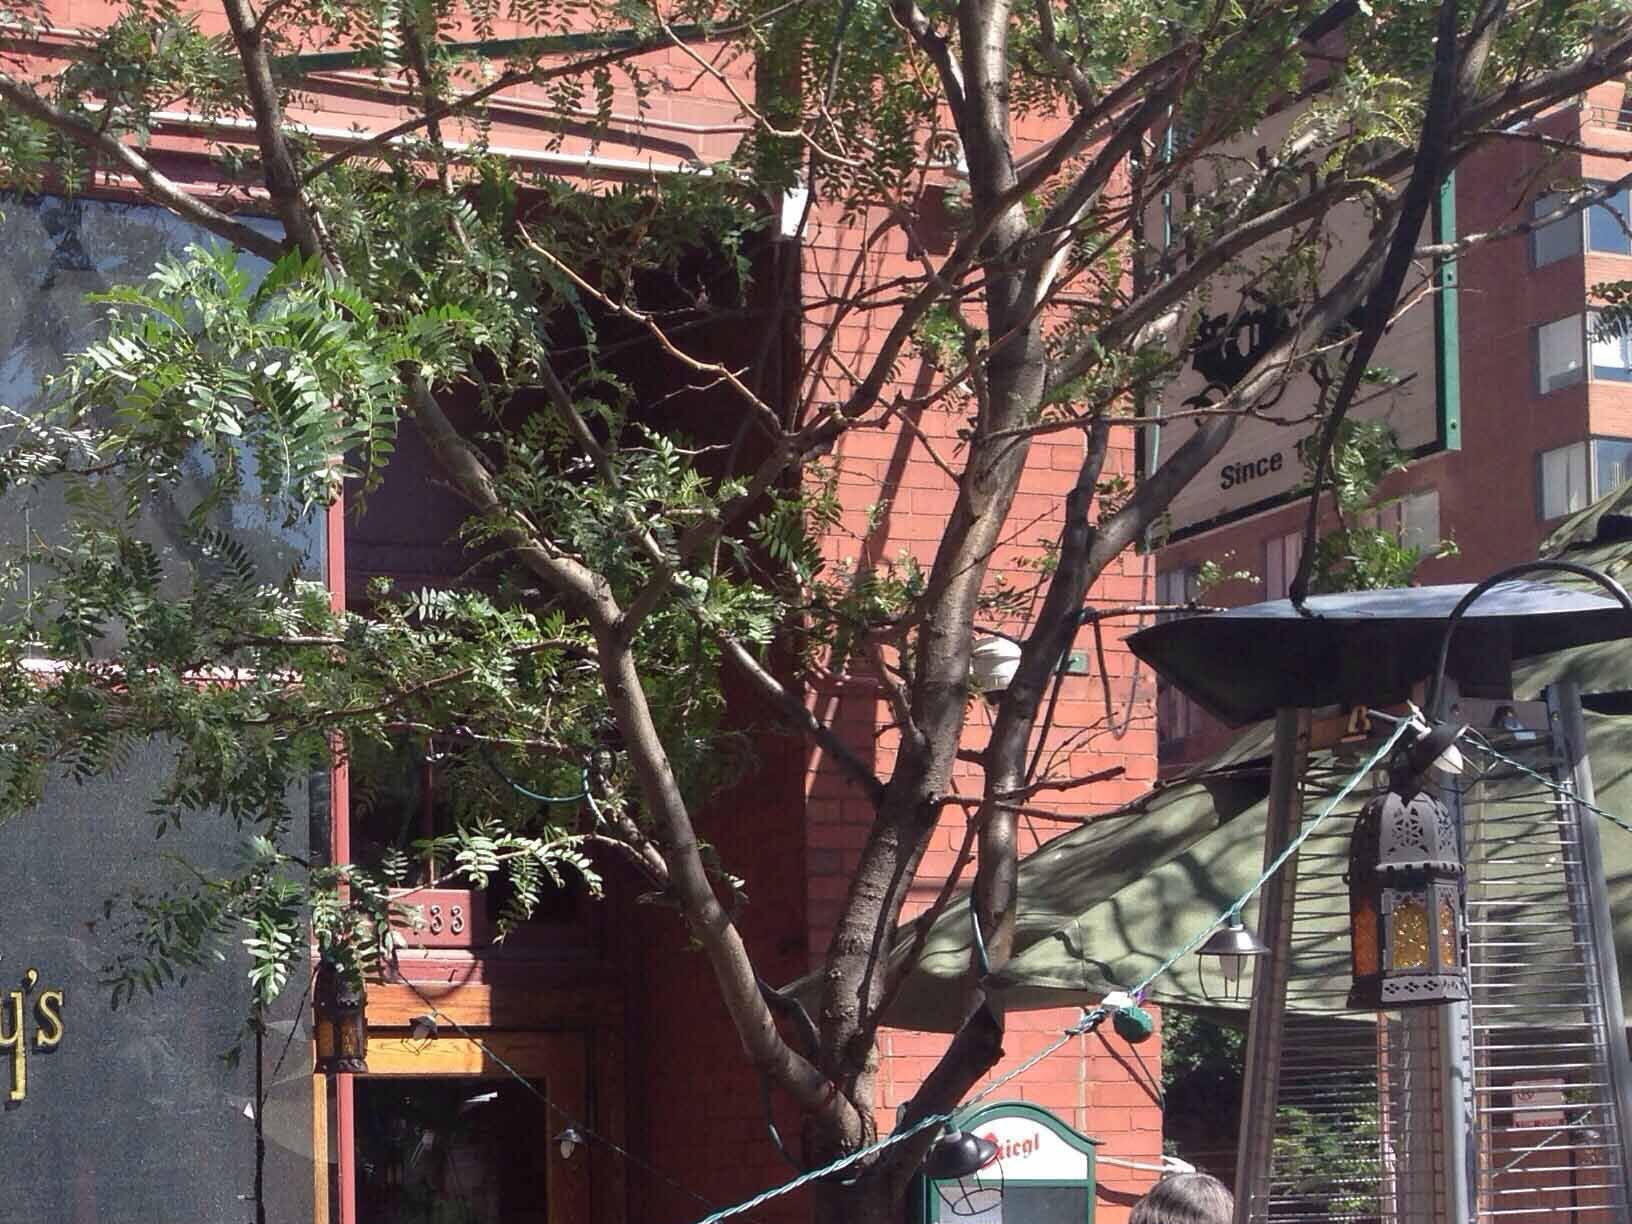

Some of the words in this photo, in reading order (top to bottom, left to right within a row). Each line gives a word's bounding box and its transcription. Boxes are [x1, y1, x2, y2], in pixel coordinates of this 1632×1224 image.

[1220, 452, 1283, 490] Since
[412, 904, 465, 932] 33
[980, 1132, 1040, 1169] tiegl
